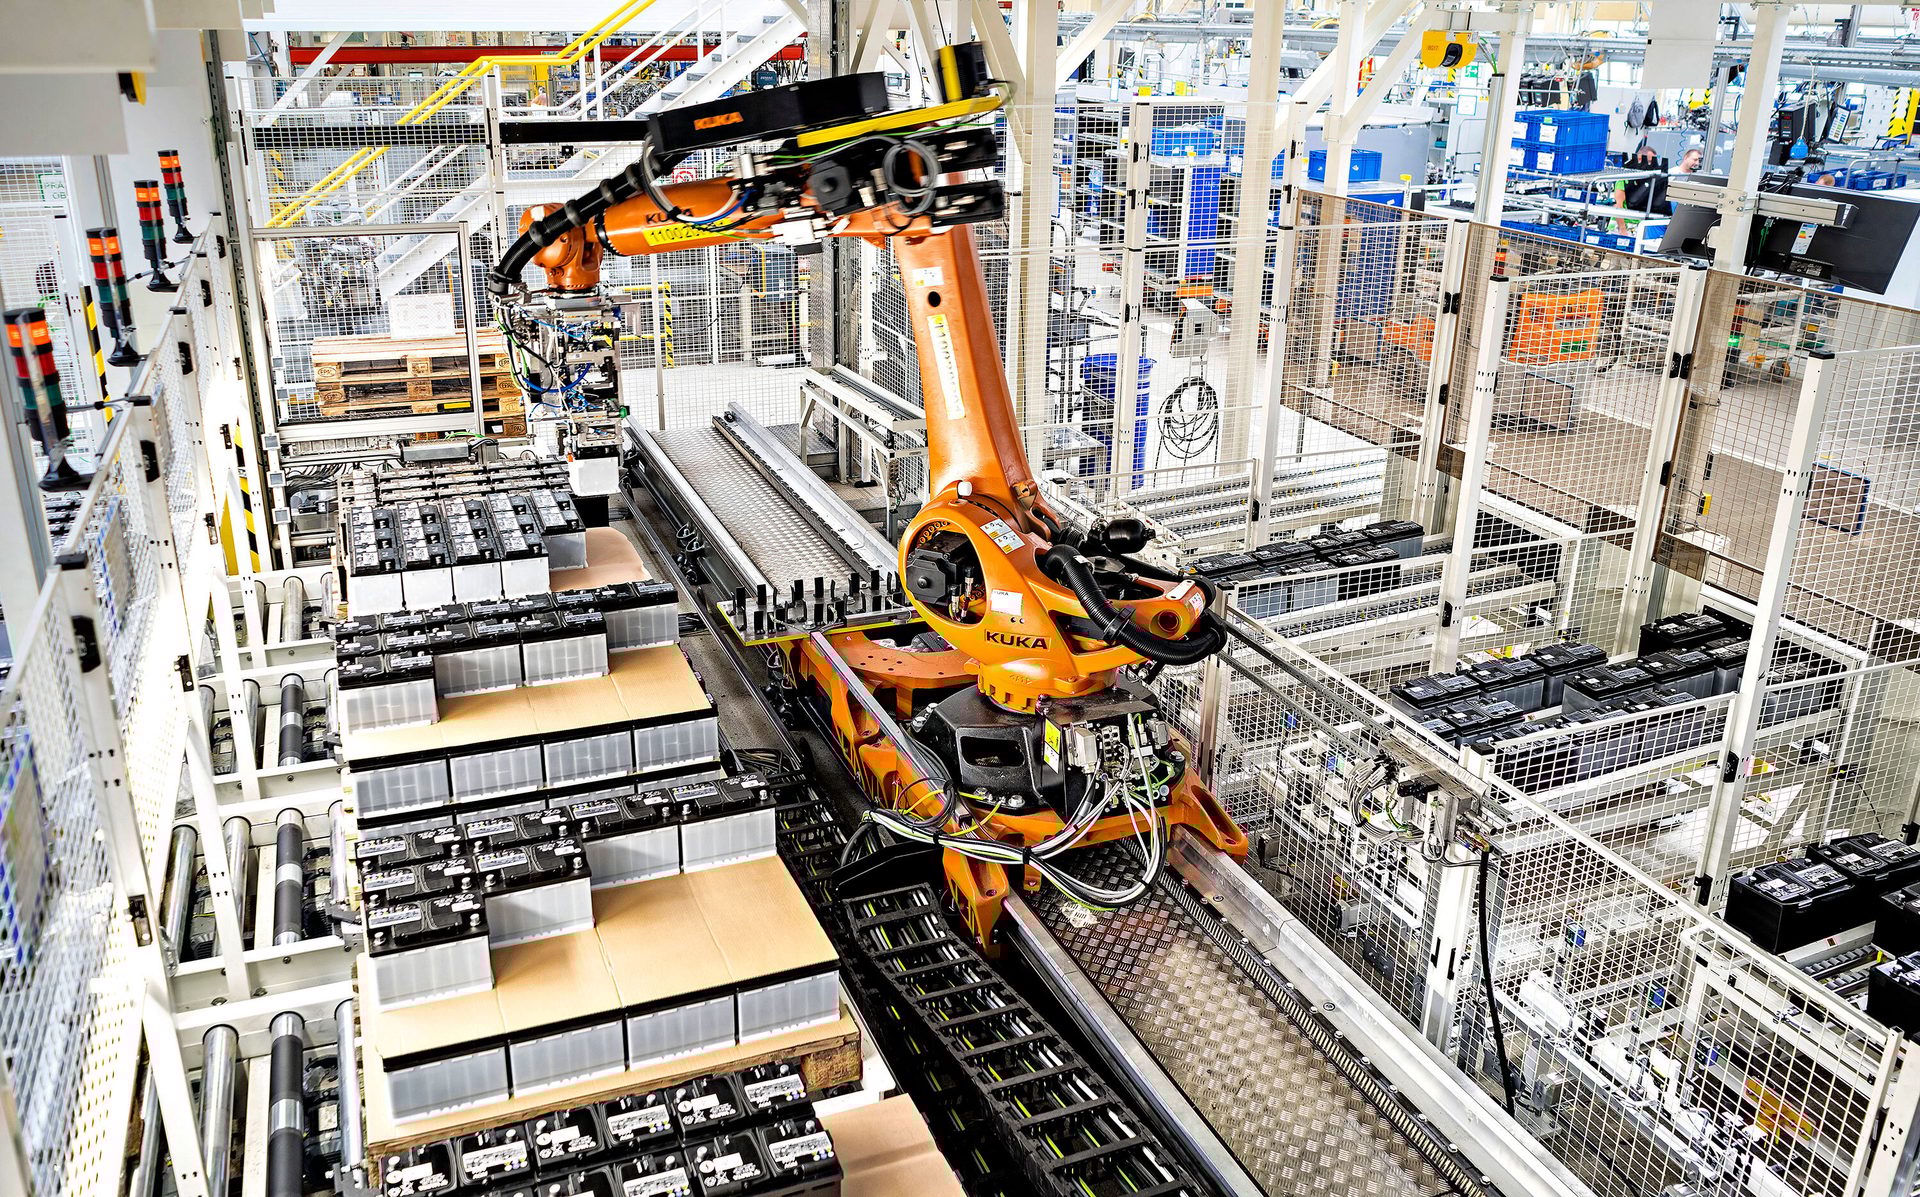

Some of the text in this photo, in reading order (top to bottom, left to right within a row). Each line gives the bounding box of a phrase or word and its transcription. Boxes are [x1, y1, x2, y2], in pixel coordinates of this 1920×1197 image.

[694, 112, 743, 130] KUKA
[645, 208, 694, 225] KUA
[987, 631, 1047, 650] KUKA
